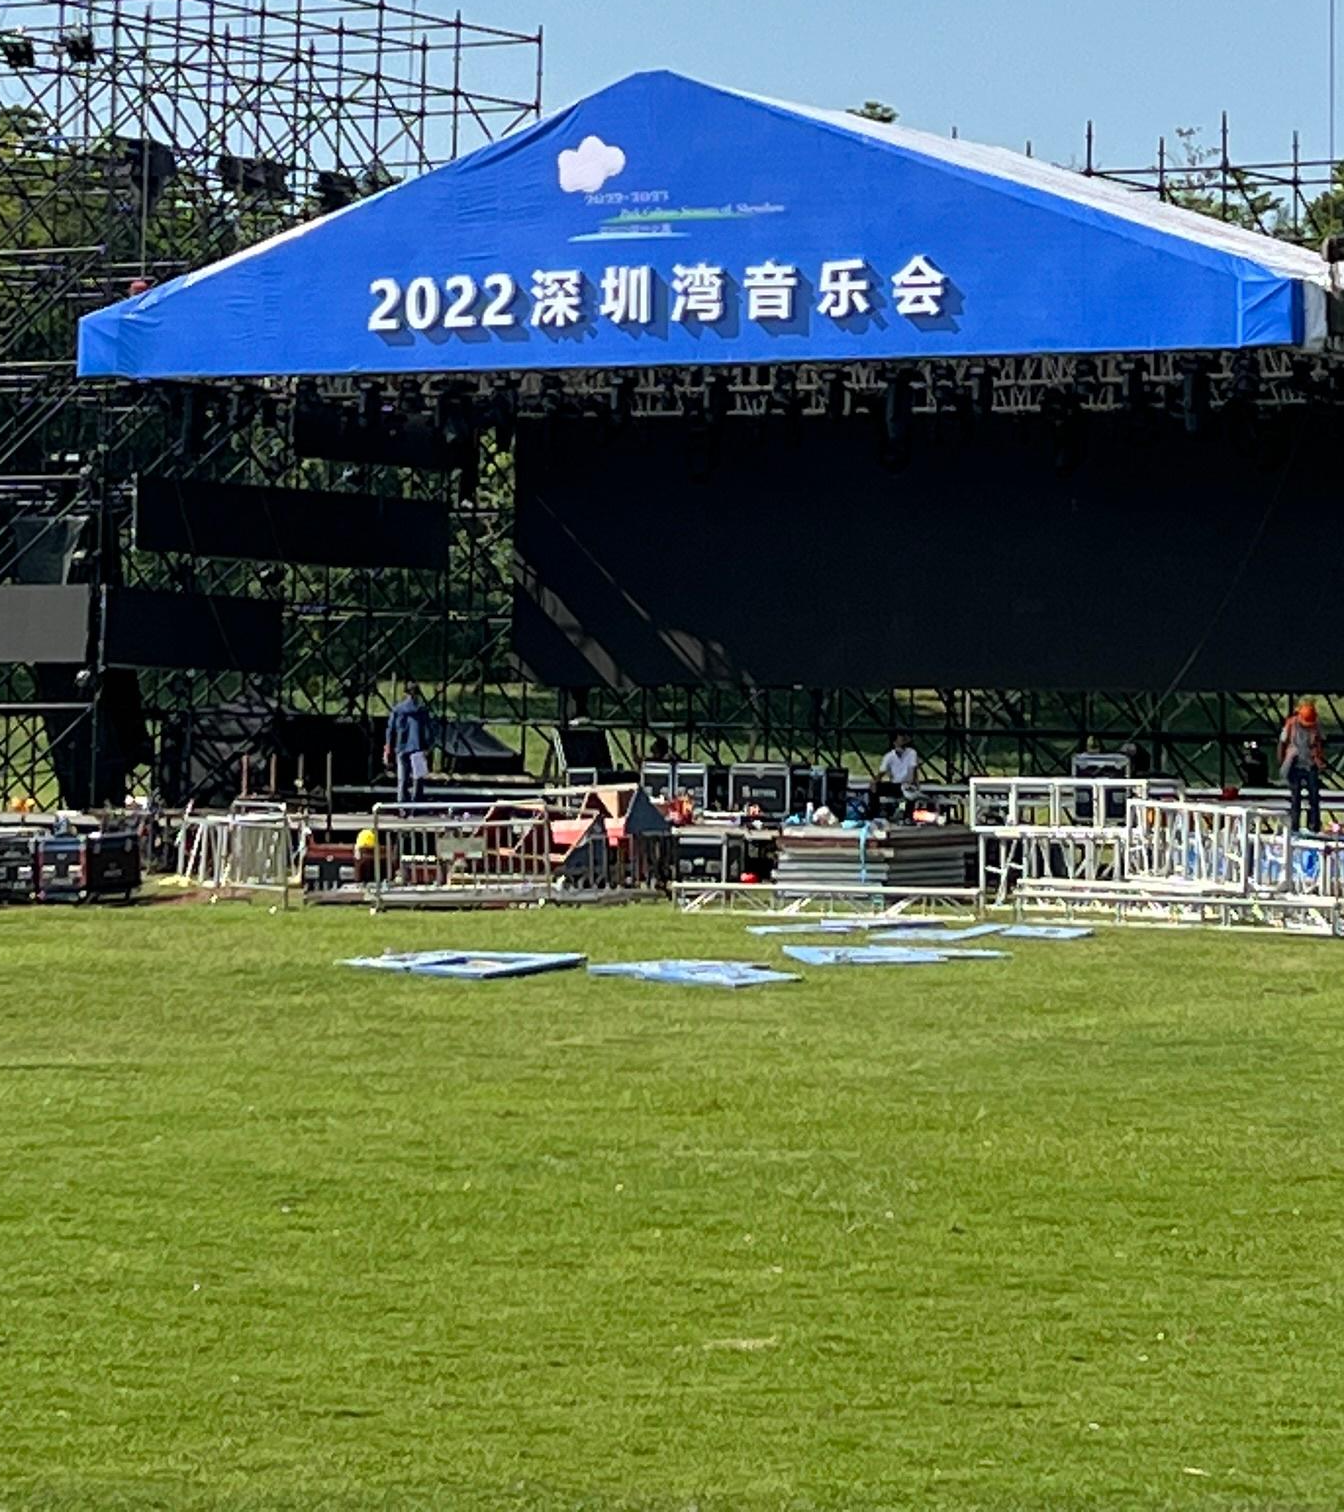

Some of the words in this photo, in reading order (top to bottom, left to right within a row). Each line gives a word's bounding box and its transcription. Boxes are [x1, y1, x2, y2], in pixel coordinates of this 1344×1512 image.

[367, 255, 946, 331] 2022深圳湾音乐会
